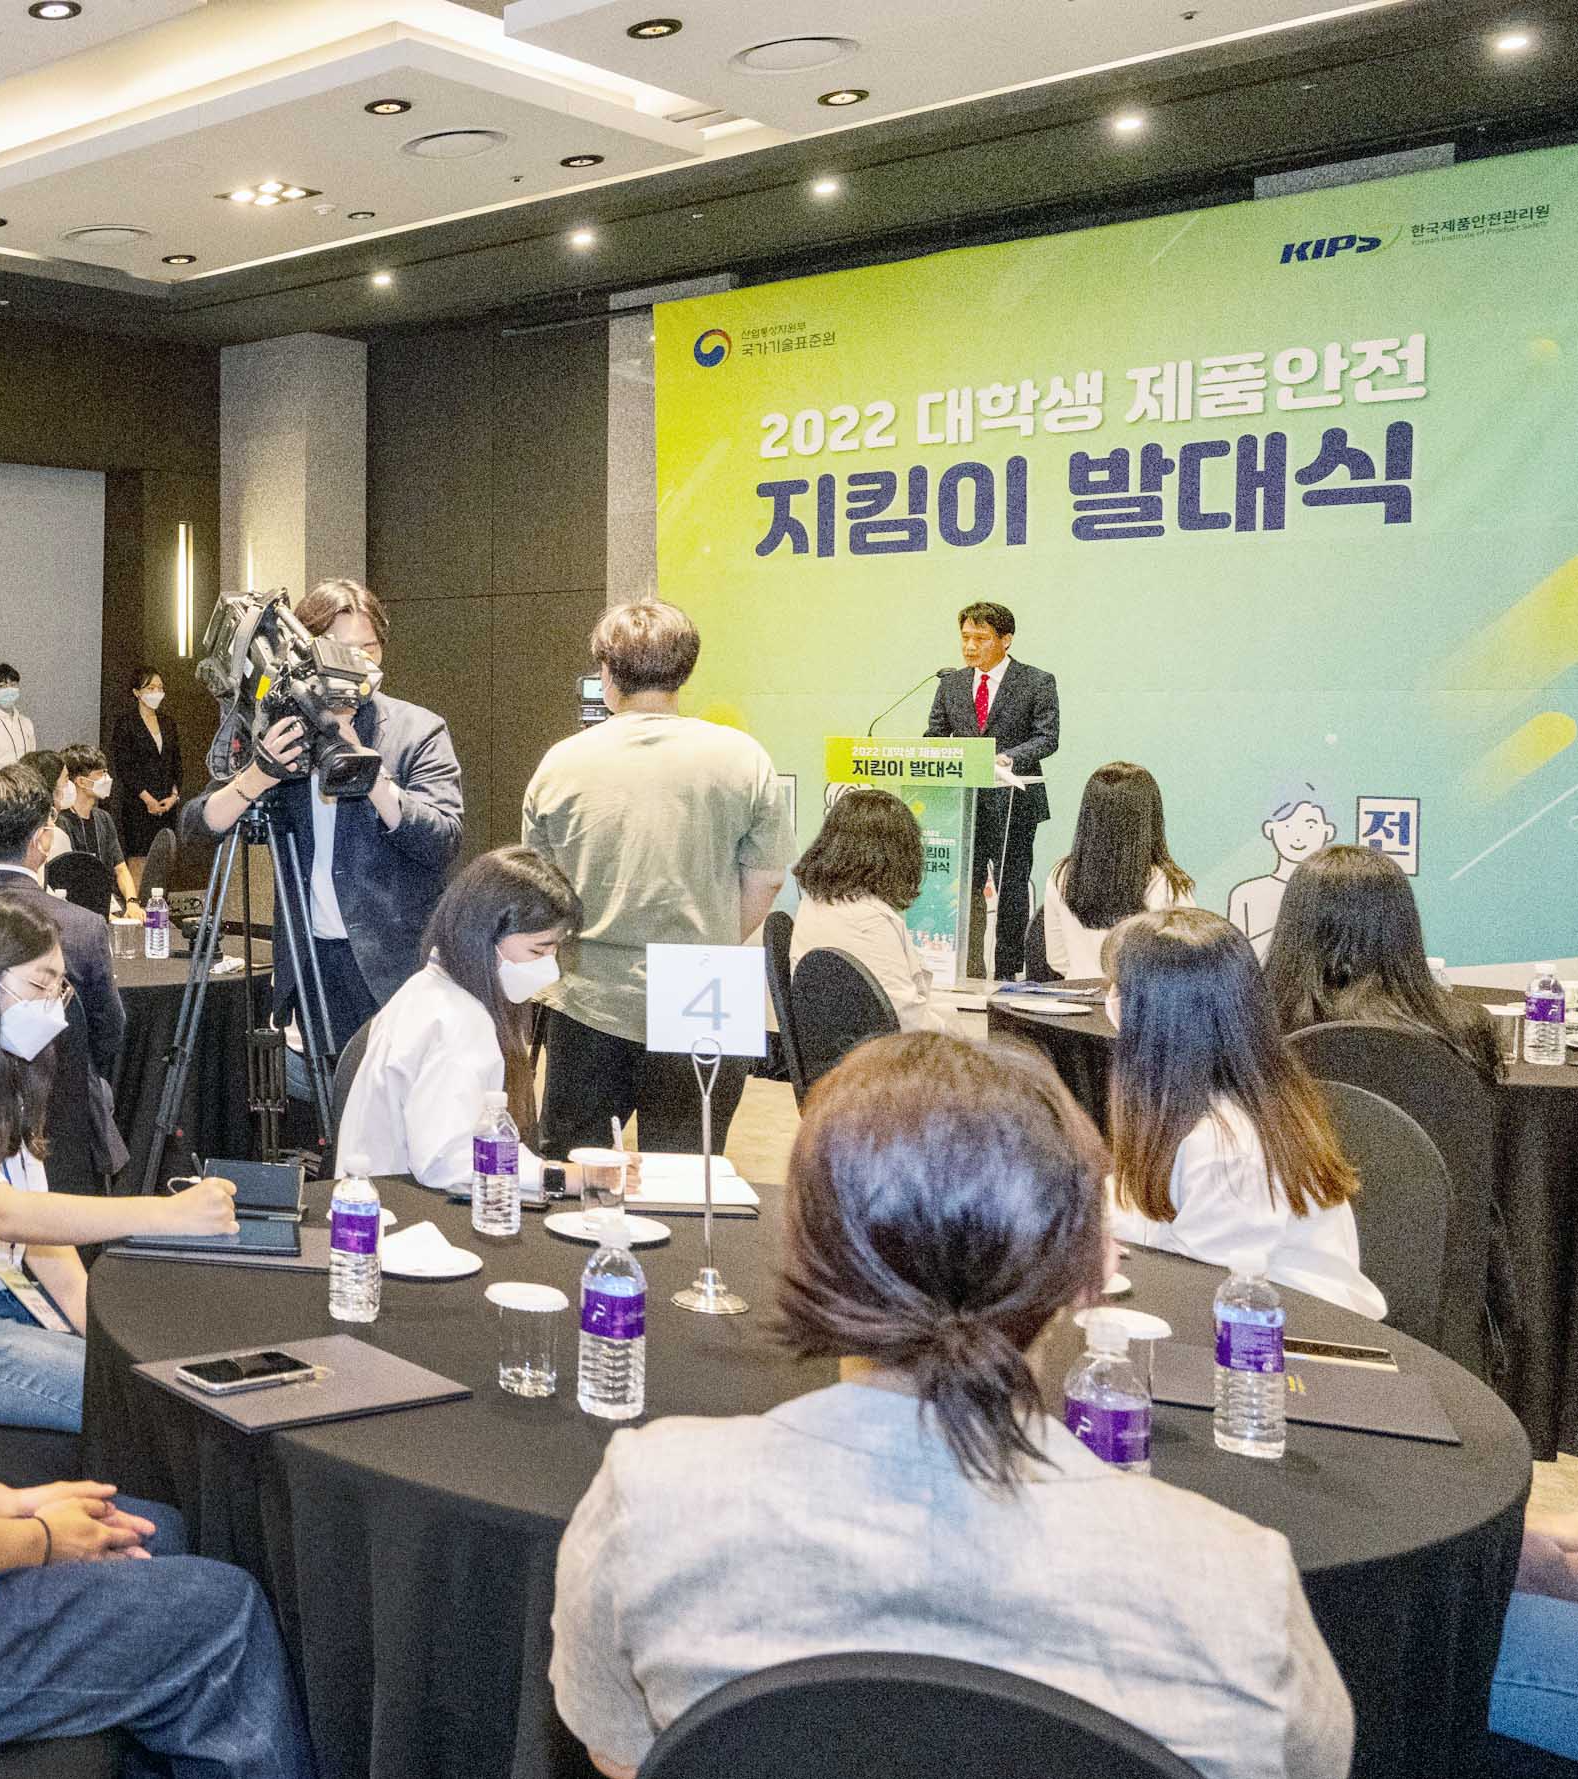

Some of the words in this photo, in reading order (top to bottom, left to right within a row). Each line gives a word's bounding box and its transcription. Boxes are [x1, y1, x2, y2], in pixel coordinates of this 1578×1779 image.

[1411, 203, 1550, 238] 한국제품안전관리원
[741, 330, 836, 357] 국가기술표준원
[759, 399, 897, 461] 2022
[916, 366, 1103, 447] 대학생
[1124, 333, 1430, 424] 제품안전
[754, 454, 1028, 560] 지킴이
[1068, 419, 1415, 543] 발대식
[852, 759, 903, 777] 지킴이
[909, 760, 963, 778] 발대식
[1363, 811, 1410, 856] 전
[925, 861, 950, 874] 대식
[681, 977, 731, 1031] 4
